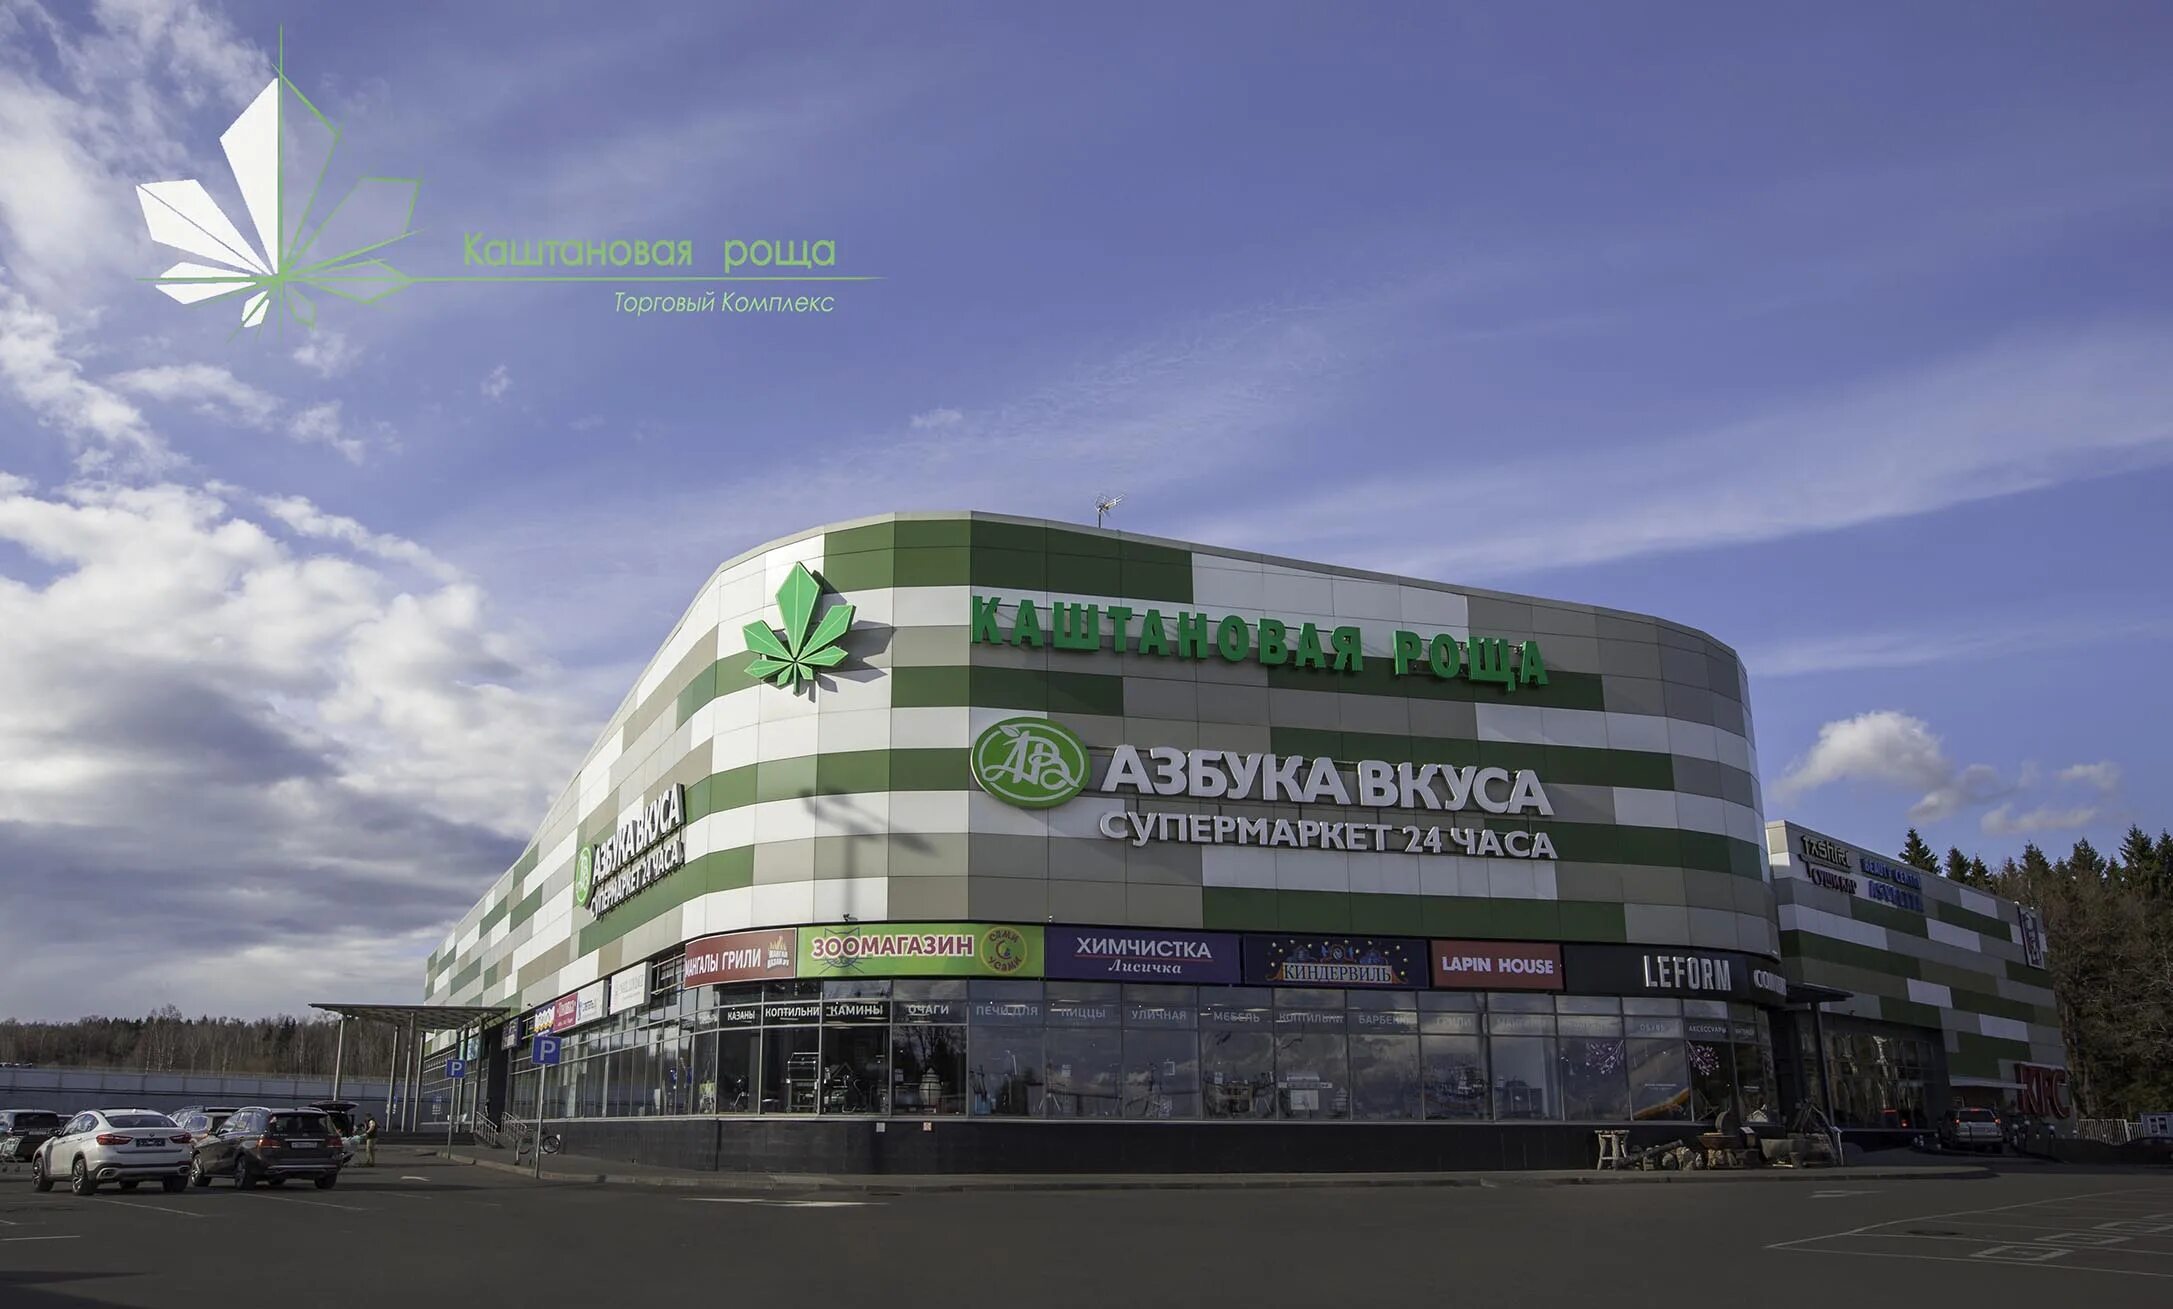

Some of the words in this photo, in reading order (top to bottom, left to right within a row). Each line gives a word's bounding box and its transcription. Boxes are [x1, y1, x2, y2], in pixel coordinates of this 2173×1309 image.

[971, 596, 1364, 672] КАШТАНОВАЯ
[1393, 630, 1550, 693] РОЩА
[1100, 744, 1351, 806] АЗБУКА
[1357, 760, 1555, 817] ВКУСА
[592, 820, 636, 885] АЗБУКА
[636, 783, 685, 851] ВКУСА
[1099, 811, 1392, 853] СУПЕРМАРКЕТ
[1402, 826, 1442, 854] 24
[1450, 828, 1559, 860] ЧАСА
[591, 869, 640, 920] СУПЕРМАРКЕТ
[652, 840, 682, 880] ЧАСА
[811, 935, 974, 960] ЗООМАГАЗИН
[1076, 936, 1212, 960] ХИМЧИСТКА
[685, 953, 719, 978] МАНГАЛЫ
[722, 948, 762, 970] ГРИЛИ
[1107, 957, 1183, 976] Лисичка
[1442, 956, 1492, 973] LAPIN
[1498, 958, 1554, 975] HOUSE
[1284, 964, 1392, 983] КИНДЕРВИЛЬ
[1643, 955, 1732, 991] LEFORM
[727, 1010, 756, 1021] КАЗАНЫ
[765, 1006, 820, 1018] КОПТИЛЬНИ
[830, 1004, 884, 1016] КАМИНЫ
[908, 1004, 950, 1016] ОЧАГИ
[976, 1005, 1008, 1017] ПЕЧИ
[1012, 1006, 1039, 1017] ДЛЯ
[1131, 1010, 1187, 1021] УЛИЧНАЯ
[1213, 1011, 1260, 1023] МЕБЕЛЬ
[539, 1039, 556, 1061] P
[450, 1060, 463, 1077] P
